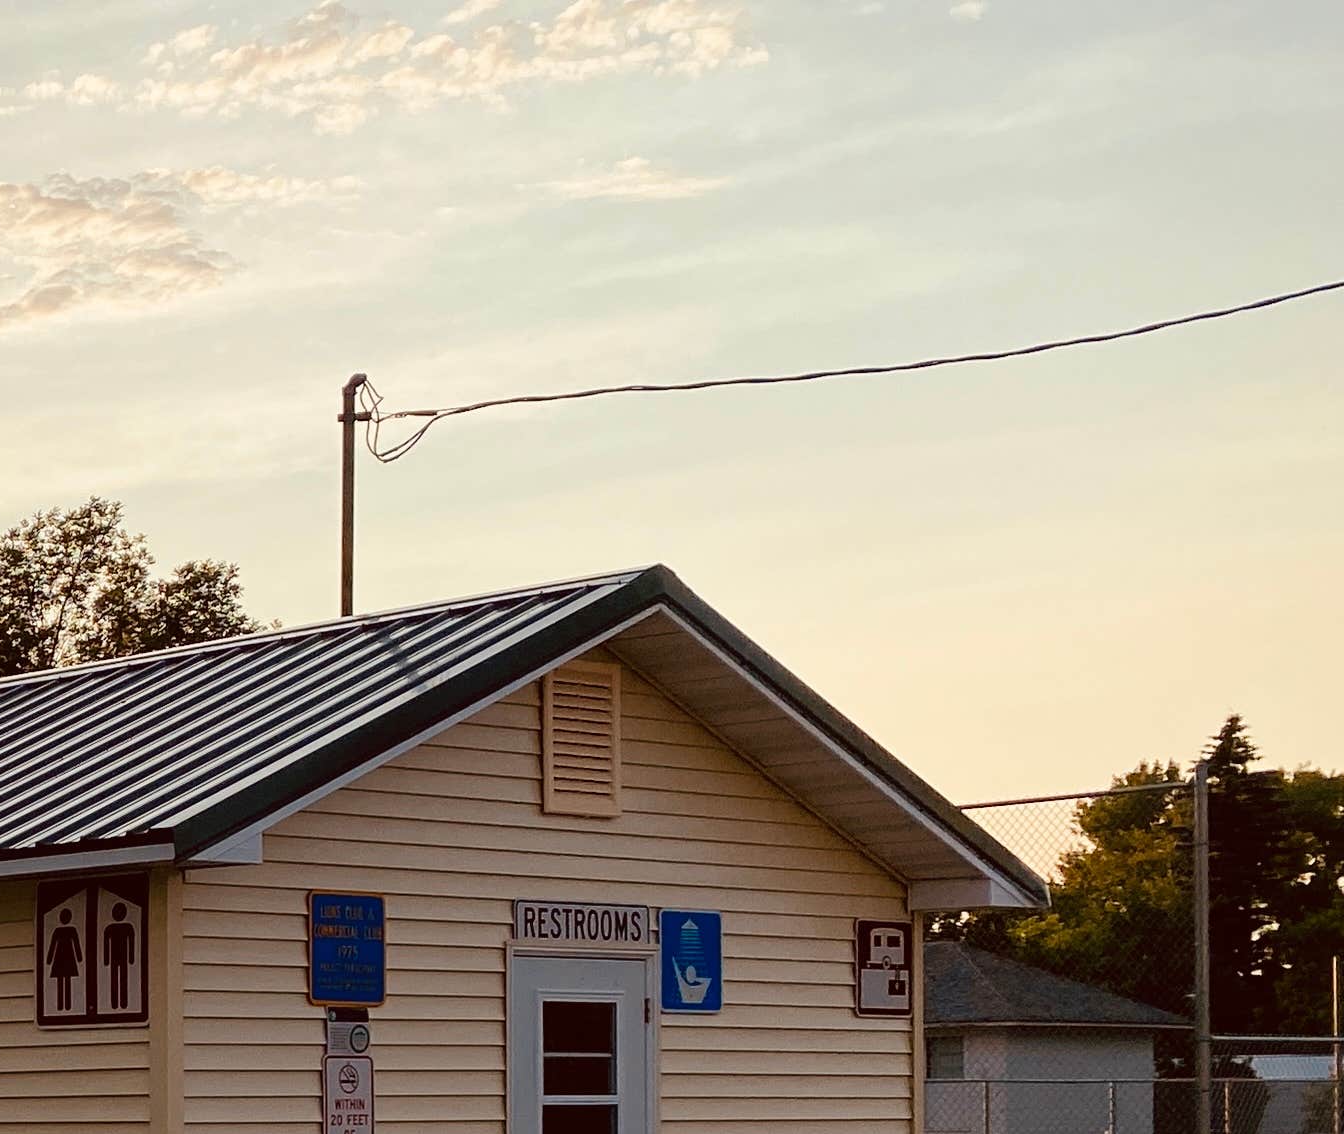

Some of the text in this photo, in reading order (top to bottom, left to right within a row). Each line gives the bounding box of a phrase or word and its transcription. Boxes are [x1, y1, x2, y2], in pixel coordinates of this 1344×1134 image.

[524, 906, 642, 942] RESTROOMS
[334, 1099, 365, 1111] WITHIN
[330, 1114, 369, 1126] 20 FEET
